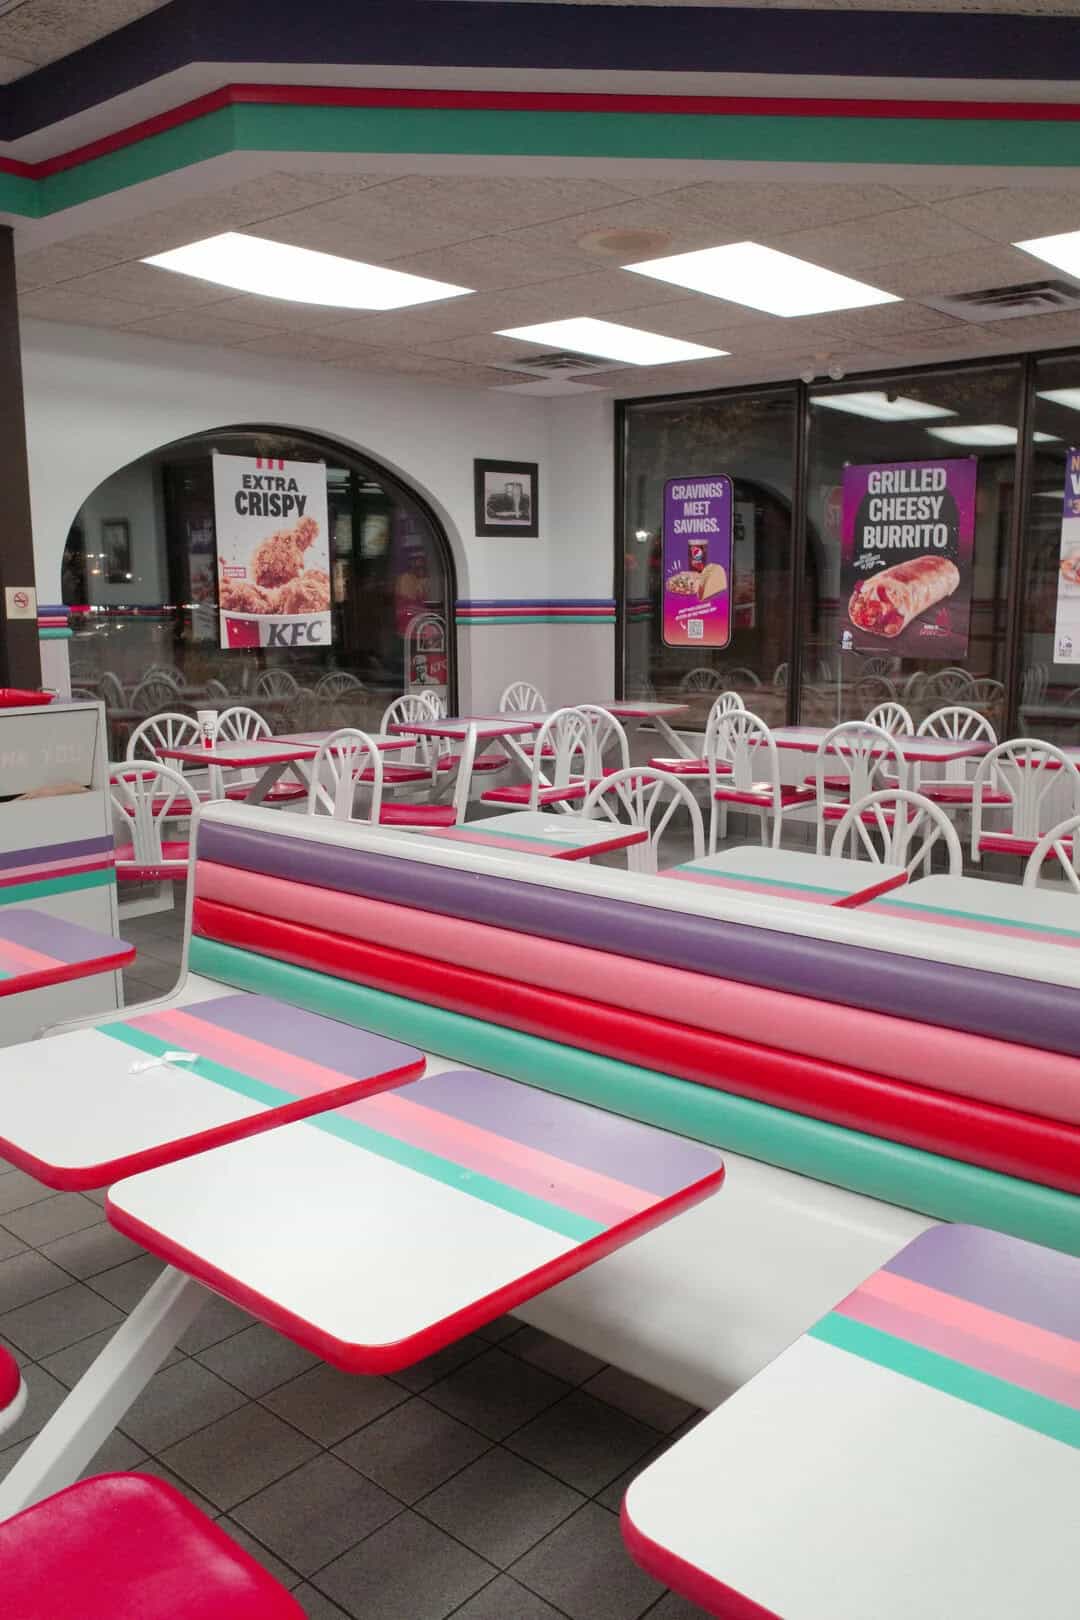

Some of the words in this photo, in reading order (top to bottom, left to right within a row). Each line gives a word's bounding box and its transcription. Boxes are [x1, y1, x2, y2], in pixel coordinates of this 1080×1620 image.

[242, 474, 298, 492] EXTRA
[672, 482, 723, 500] CRAVINGS
[867, 468, 947, 494] GRILLED
[235, 490, 307, 518] CRISPY
[683, 500, 711, 517] MEET
[868, 496, 944, 521] CHEESY
[673, 517, 720, 534] SAVINGS.
[863, 523, 948, 549] BURRITO
[266, 621, 323, 647] KFC
